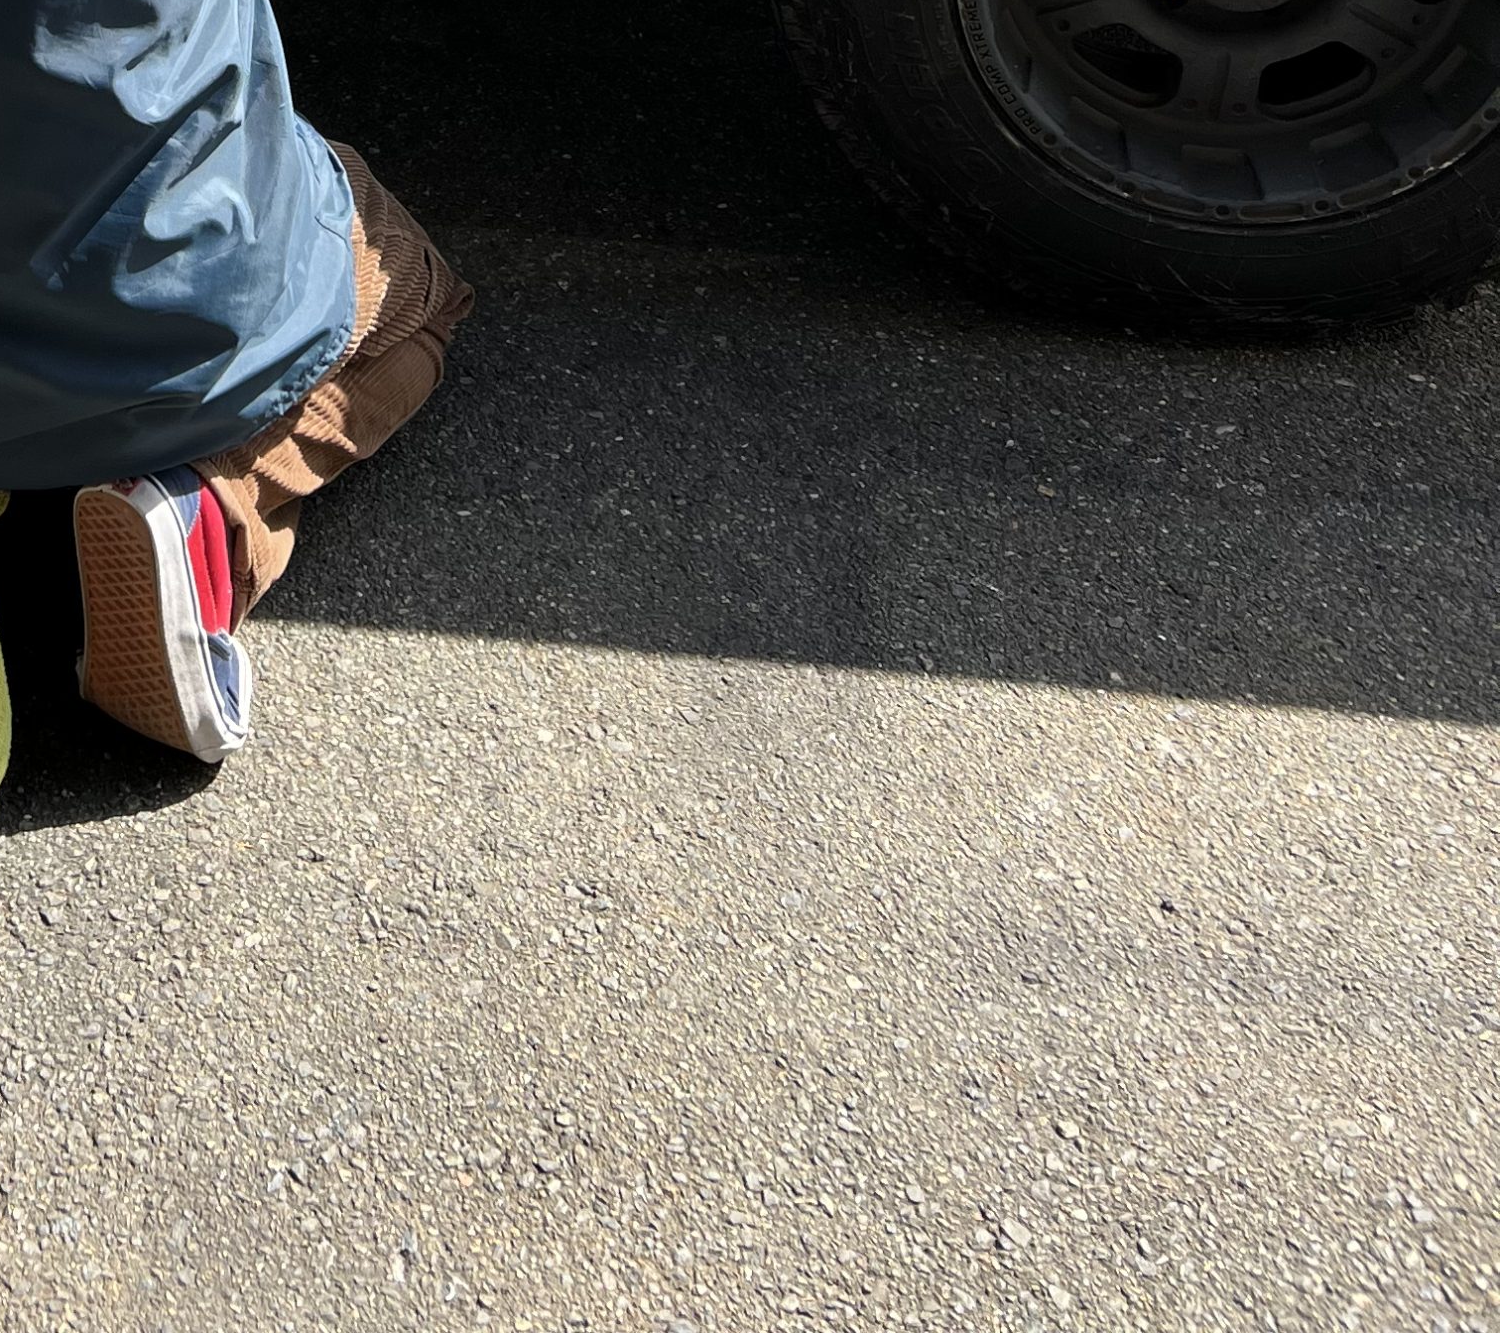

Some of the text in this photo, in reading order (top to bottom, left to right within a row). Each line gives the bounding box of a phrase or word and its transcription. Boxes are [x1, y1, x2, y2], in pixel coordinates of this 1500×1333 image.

[962, 0, 1043, 136] PRO COMP XTREME
